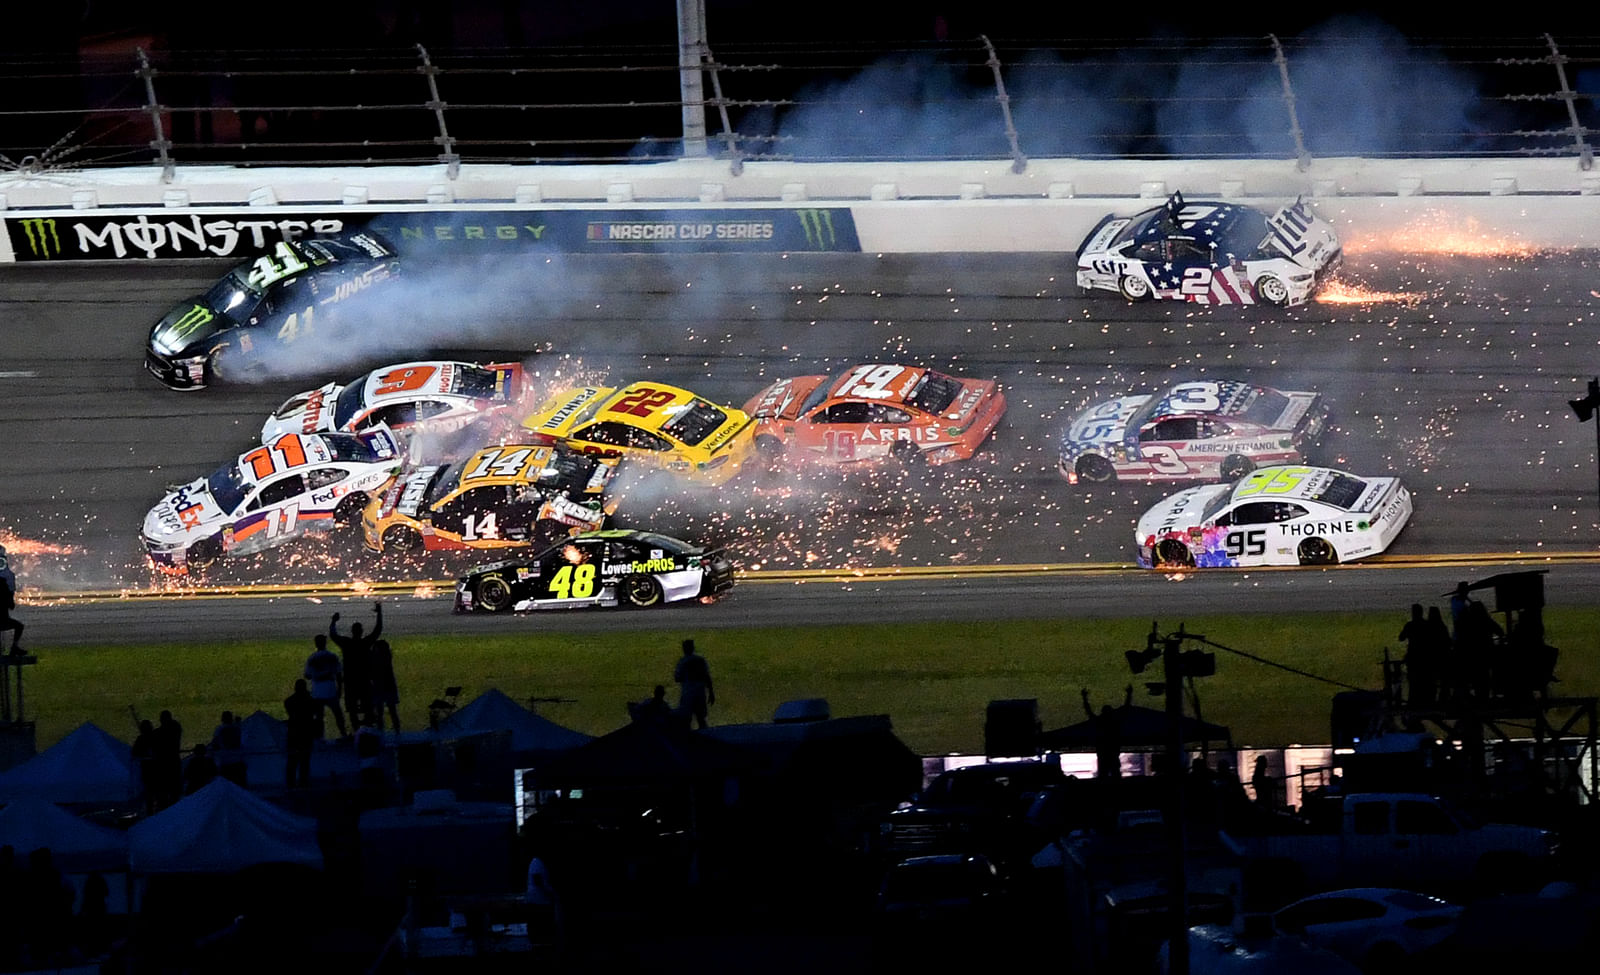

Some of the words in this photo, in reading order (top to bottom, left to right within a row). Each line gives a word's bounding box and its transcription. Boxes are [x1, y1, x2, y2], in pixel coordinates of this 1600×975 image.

[609, 225, 675, 239] NASCAR
[680, 224, 713, 239] CUP
[717, 223, 773, 238] SERIES
[247, 241, 309, 288] 41
[1180, 267, 1213, 295] 2
[277, 305, 314, 342] 41
[833, 364, 906, 398] 19
[1168, 381, 1221, 411] 3
[542, 388, 596, 428] PENNZOIL
[608, 388, 677, 418] 22
[824, 430, 856, 459] 19
[860, 426, 939, 443] ARRIS
[1188, 442, 1233, 454] AMERICAN
[1234, 438, 1278, 452] ETHANOL
[243, 433, 308, 480] 11
[464, 449, 531, 480] 14
[1141, 445, 1189, 474] 3
[311, 485, 348, 505] FedEx
[1240, 467, 1312, 497] 95
[1300, 469, 1328, 498] THORNE
[170, 484, 204, 532] FedEx
[264, 501, 300, 541] 11
[462, 512, 498, 542] 14
[1279, 520, 1354, 537] THORNE
[1226, 530, 1266, 558] 95
[549, 564, 597, 600] 48
